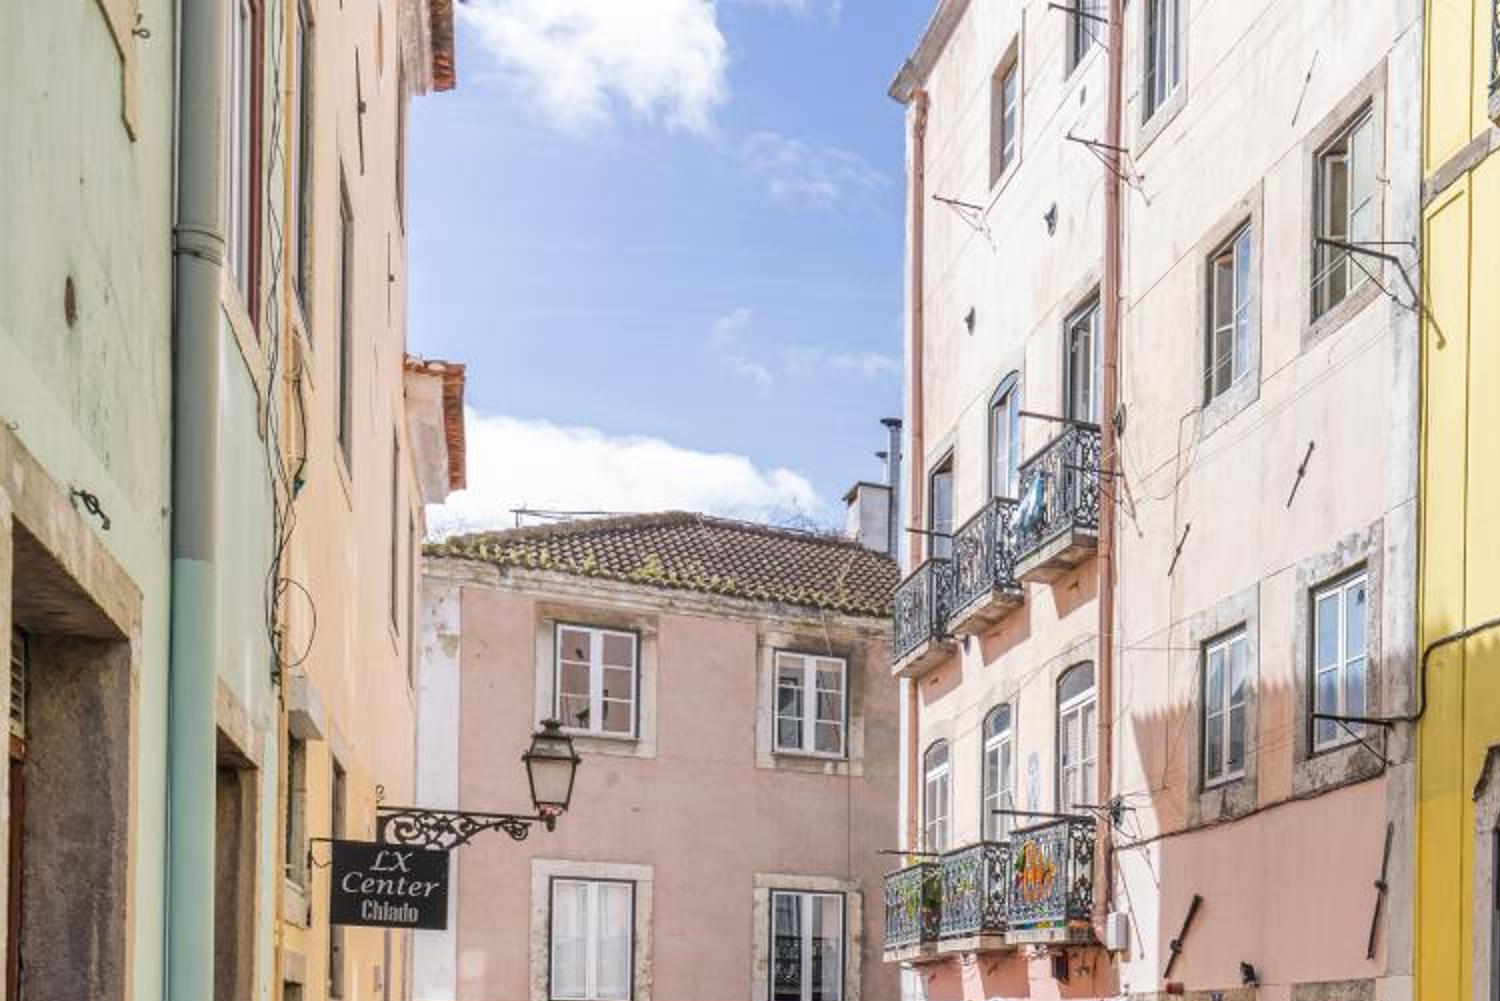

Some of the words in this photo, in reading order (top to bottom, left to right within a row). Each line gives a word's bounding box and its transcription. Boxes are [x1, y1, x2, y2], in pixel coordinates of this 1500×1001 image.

[370, 850, 415, 873] LX
[341, 871, 440, 898] Center
[361, 899, 419, 924] Chiado
